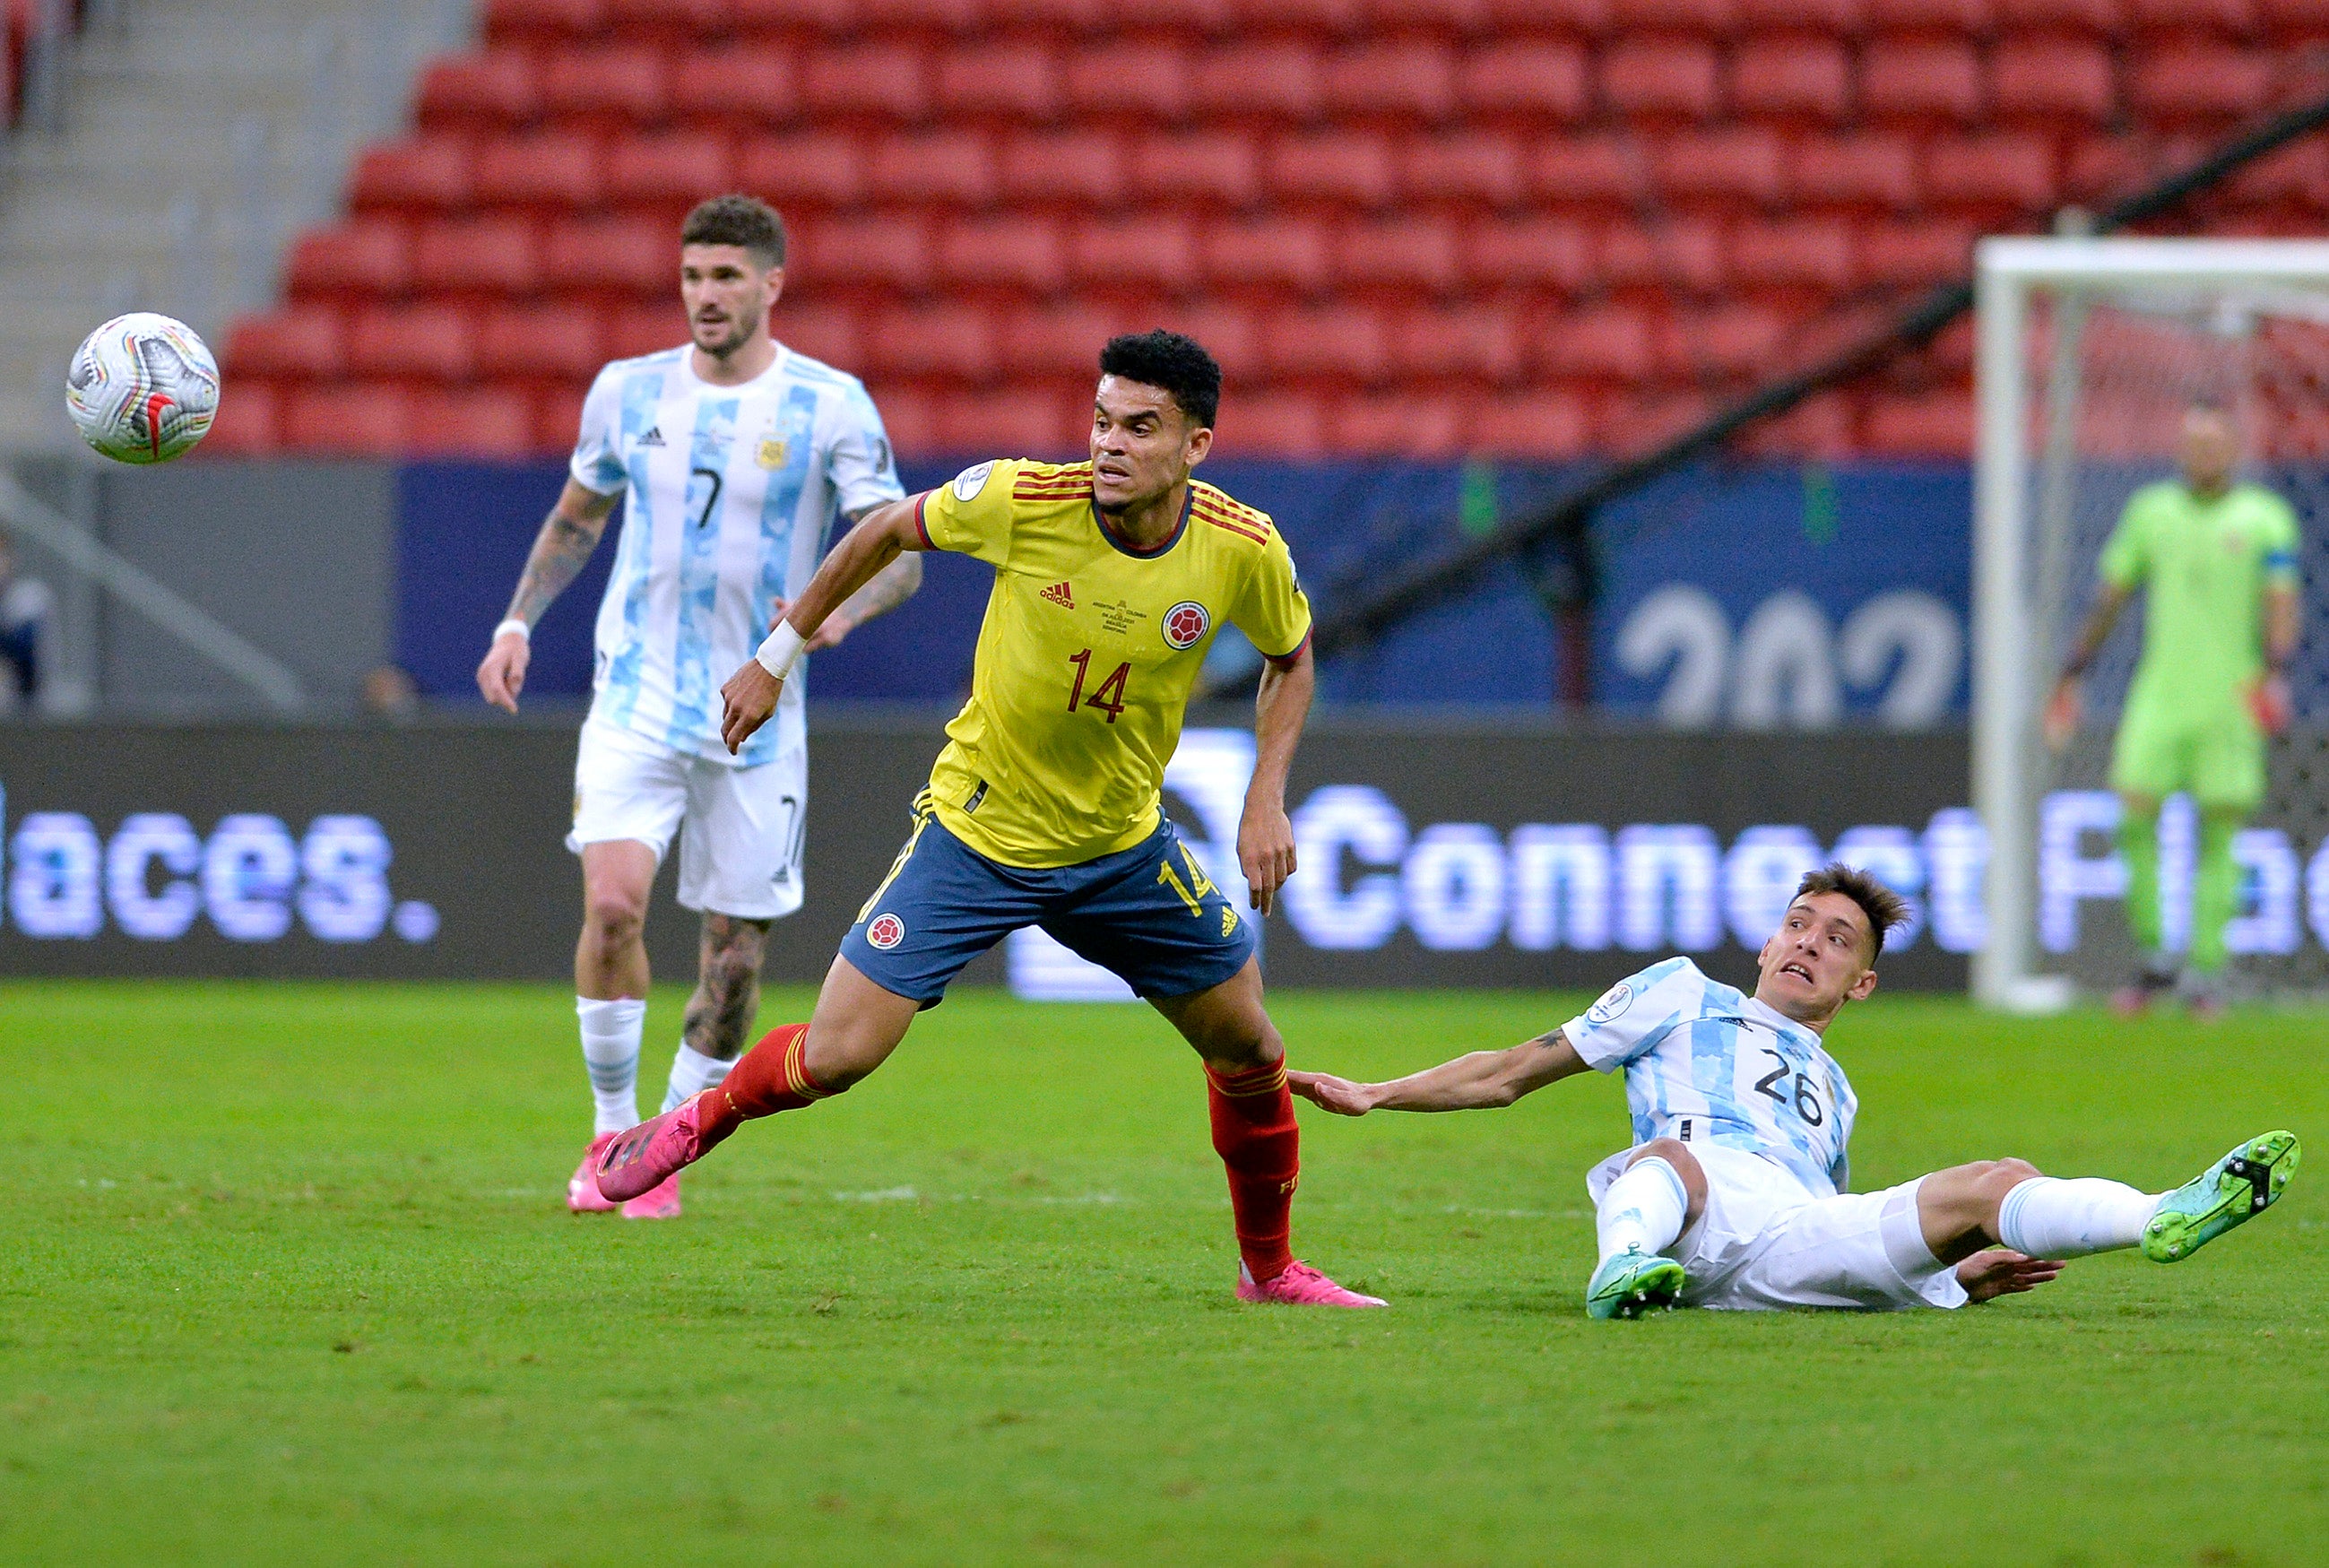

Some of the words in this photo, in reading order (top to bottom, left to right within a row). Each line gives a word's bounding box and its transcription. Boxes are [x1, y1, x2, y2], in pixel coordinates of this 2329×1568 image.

[692, 467, 723, 528] 7
[1040, 589, 1075, 610] adidas
[1068, 648, 1131, 723] 14
[0, 778, 441, 941] aces.
[780, 794, 797, 857] 7
[1157, 839, 1221, 918] 14
[1754, 1048, 1823, 1127] 26
